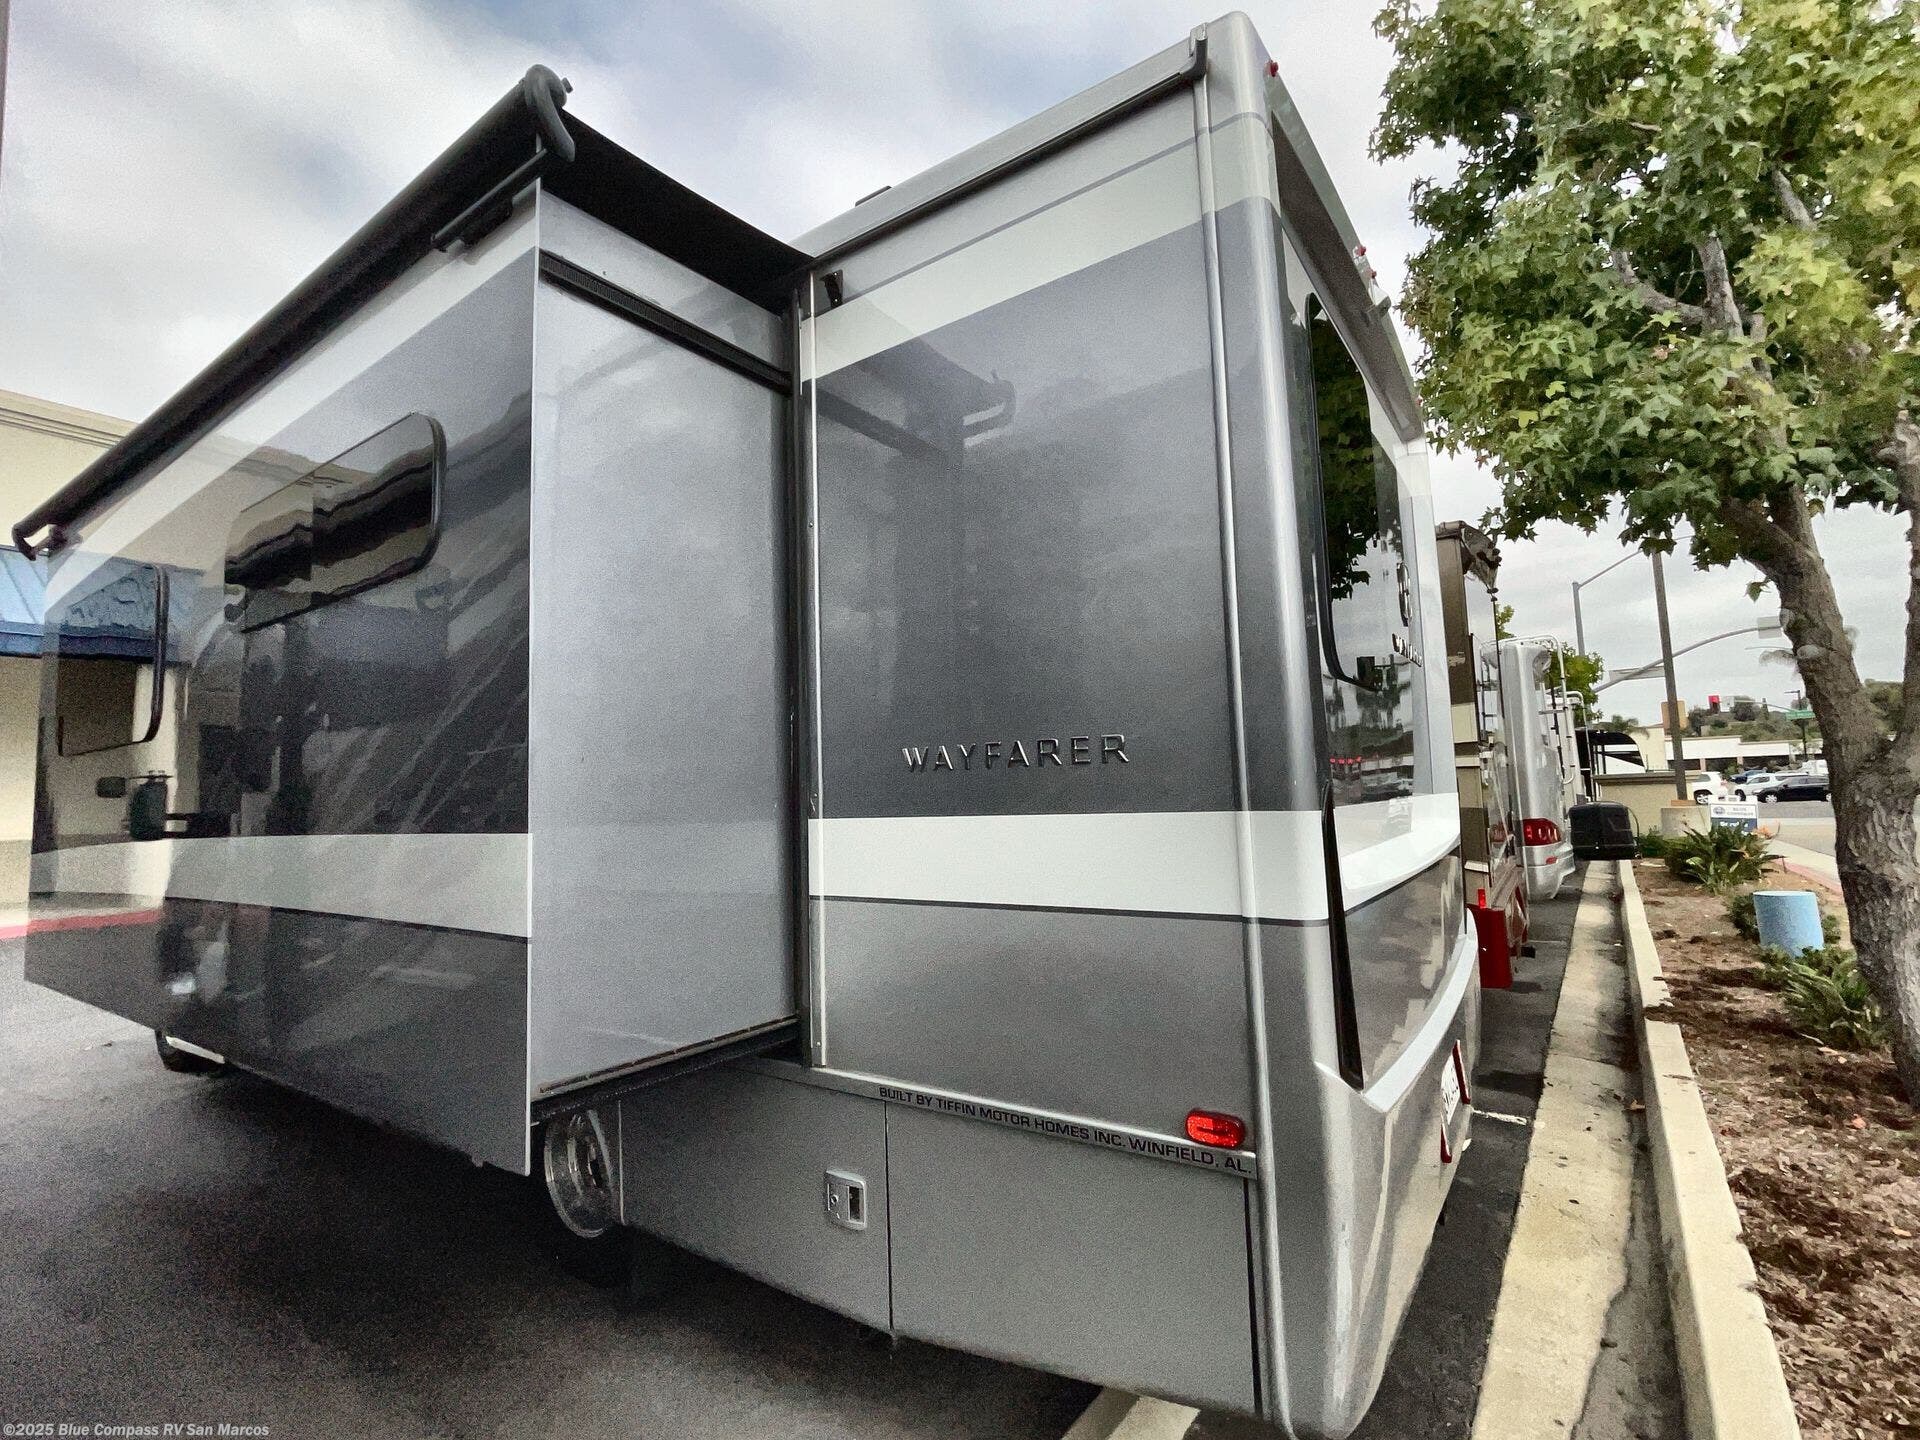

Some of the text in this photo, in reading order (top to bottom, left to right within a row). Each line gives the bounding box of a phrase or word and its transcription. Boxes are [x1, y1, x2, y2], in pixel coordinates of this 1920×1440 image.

[902, 733, 1130, 773] WAYFARER
[879, 1086, 913, 1103] BUILT
[916, 1094, 932, 1107] BY
[936, 1098, 976, 1116] TIFFIN
[979, 1107, 1031, 1127] MOTOR
[1034, 1118, 1090, 1141] HOMES
[1128, 1137, 1219, 1168] WINFIELD,
